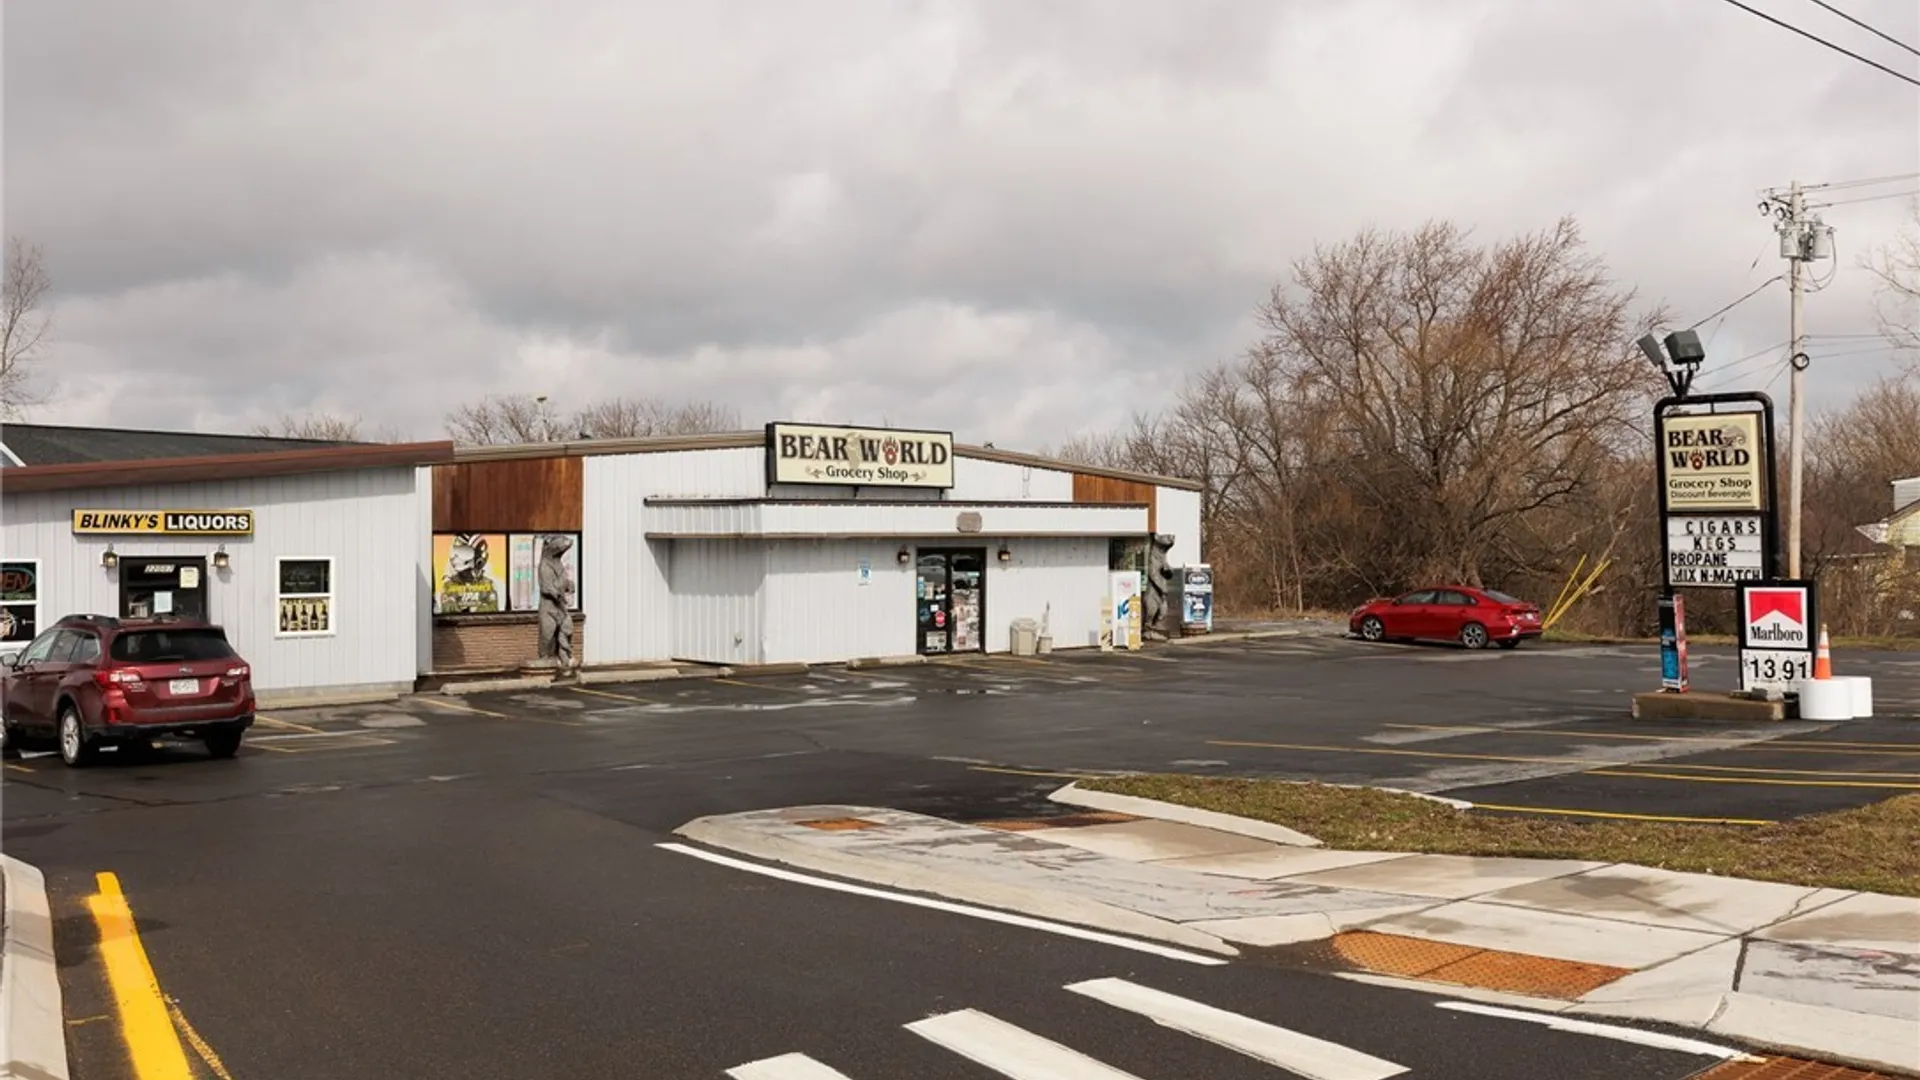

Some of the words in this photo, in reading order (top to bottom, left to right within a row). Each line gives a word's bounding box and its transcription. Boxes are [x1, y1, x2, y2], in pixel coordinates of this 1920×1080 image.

[1668, 429, 1723, 447] BEAR
[779, 433, 848, 461] BEAR
[859, 437, 948, 466] WORLD
[1670, 448, 1750, 470] WORLD
[826, 465, 874, 481] Grocery
[877, 467, 909, 482] Shop
[1669, 478, 1716, 490] Grocery
[1719, 477, 1752, 489] Shop
[1671, 490, 1706, 498] Discount
[1708, 489, 1752, 498] Beverages
[80, 514, 159, 529] BLINKY'S
[167, 515, 249, 530] LIQUORS
[1685, 520, 1757, 535] CIGARS
[1693, 537, 1737, 551] KEGS
[1671, 553, 1728, 566] PROPANE
[1672, 569, 1697, 582] MIX
[1751, 622, 1803, 642] Marlboro
